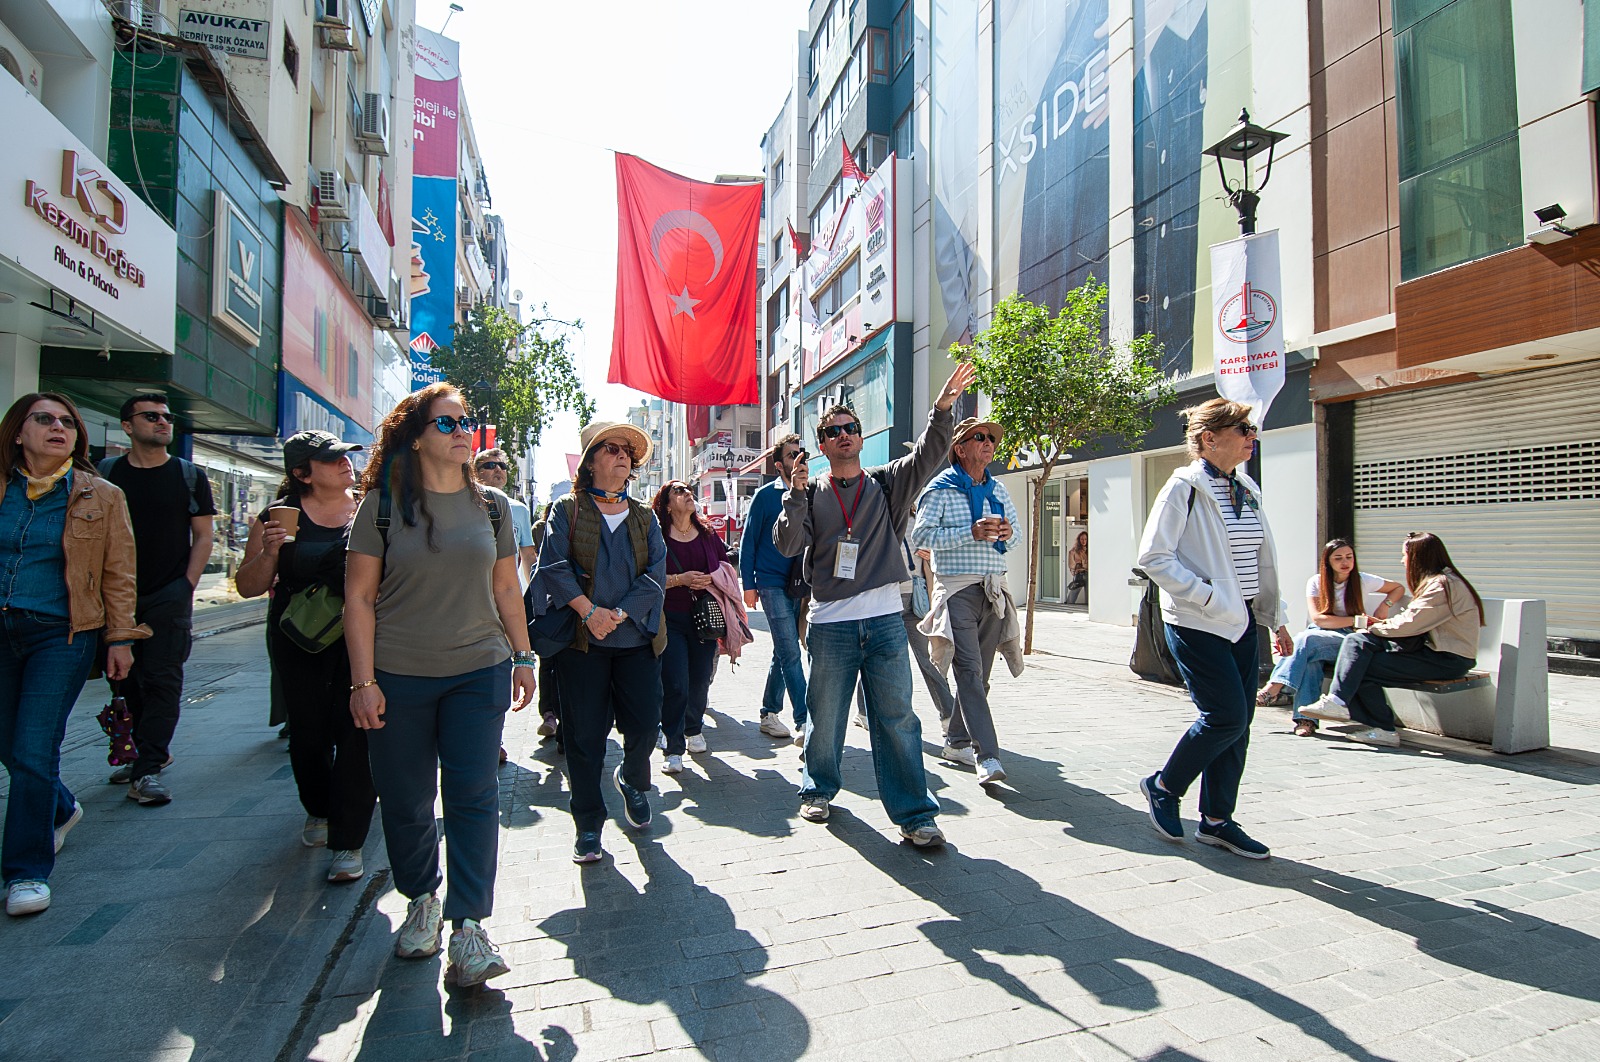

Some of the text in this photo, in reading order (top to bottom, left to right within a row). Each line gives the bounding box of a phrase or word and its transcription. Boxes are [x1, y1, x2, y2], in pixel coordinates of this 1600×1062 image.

[185, 13, 262, 32] AVUKAT
[216, 36, 231, 46] IŞIK
[234, 37, 264, 50] ÖZKAYA
[442, 105, 456, 120] ile
[998, 49, 1106, 185] XSIDE
[25, 179, 145, 288] Kazım Doğan
[867, 228, 883, 253] CHP
[54, 245, 118, 299] Altın & Pırlanta
[1220, 351, 1278, 365] KARŞIYAKA
[1220, 360, 1278, 375] BELEDİYESİ
